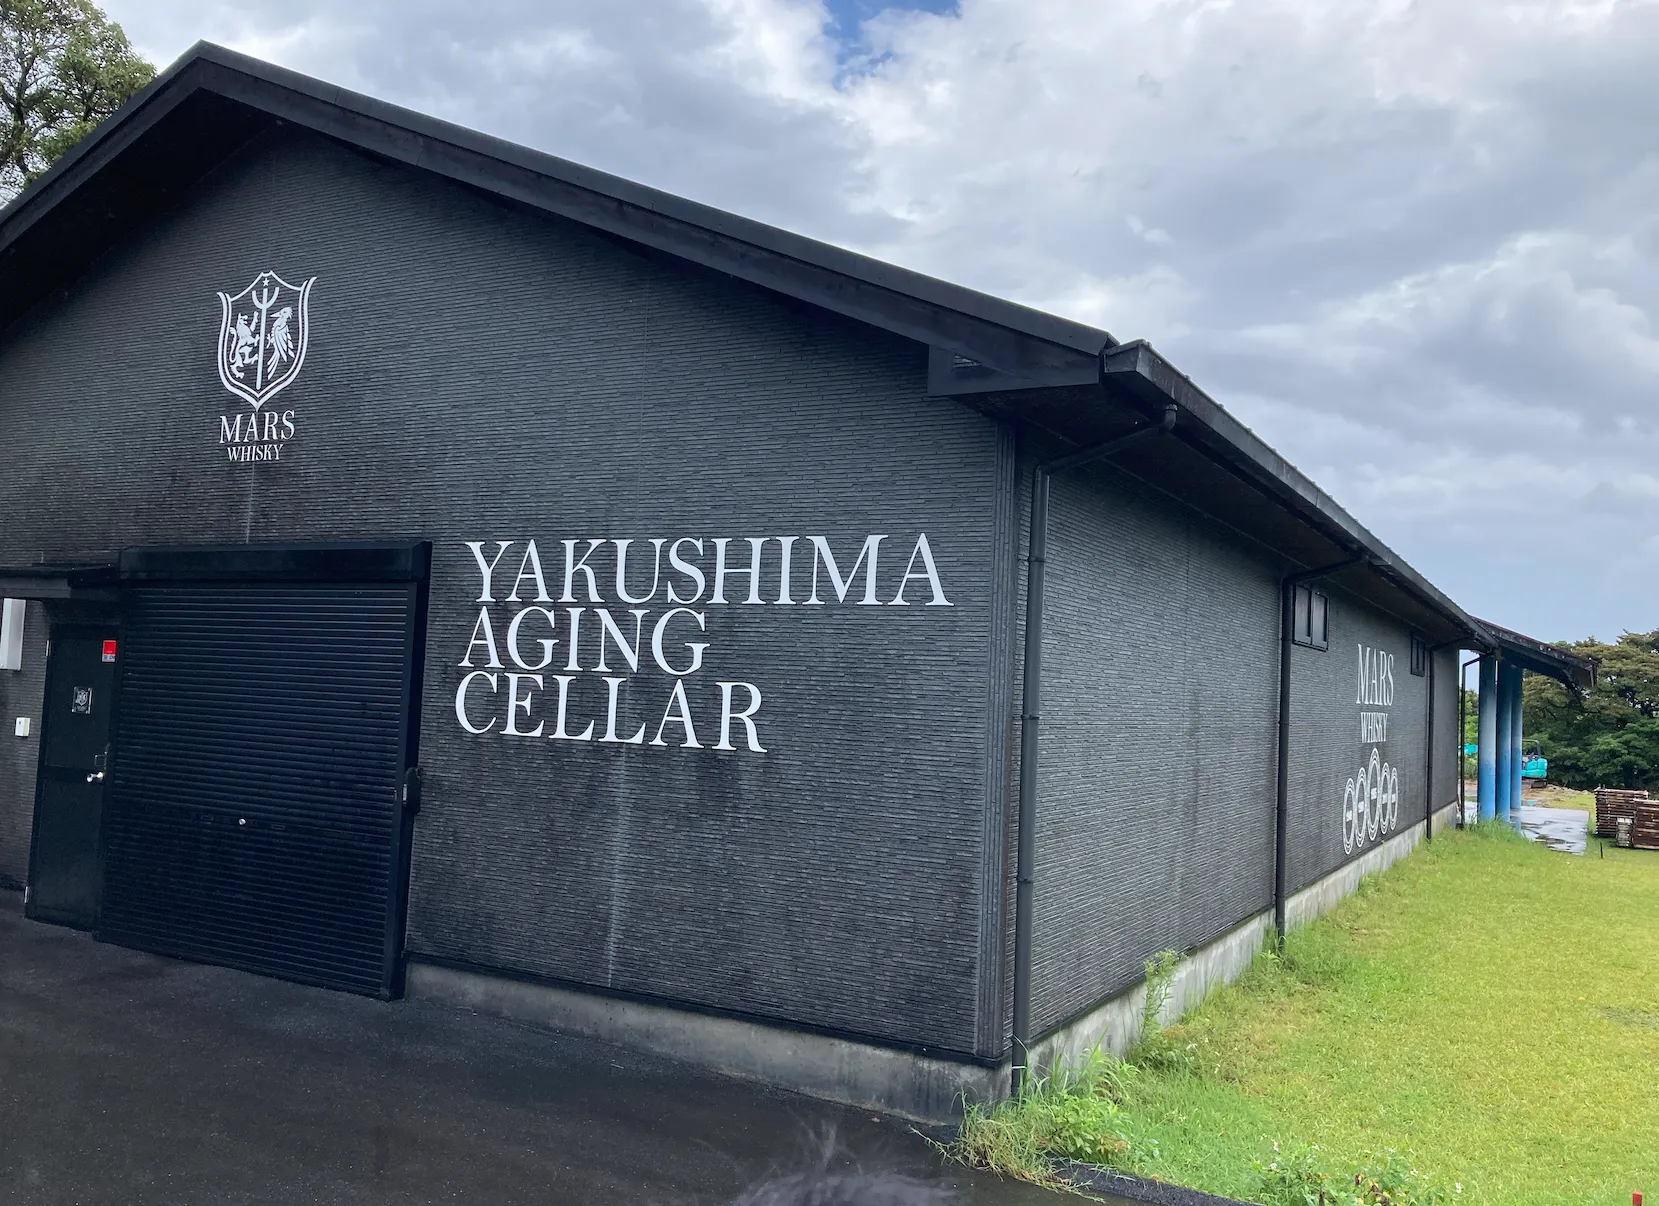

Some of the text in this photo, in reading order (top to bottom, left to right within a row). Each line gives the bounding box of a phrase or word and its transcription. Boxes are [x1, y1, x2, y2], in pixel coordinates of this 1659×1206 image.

[219, 410, 295, 444] MARS
[227, 443, 284, 462] WHISKY
[464, 533, 955, 606] YAKUSHIMA
[457, 605, 711, 675] AGING
[1356, 643, 1394, 706] MARS
[455, 671, 769, 753] CELLAR
[1360, 712, 1388, 743] WHISKY
